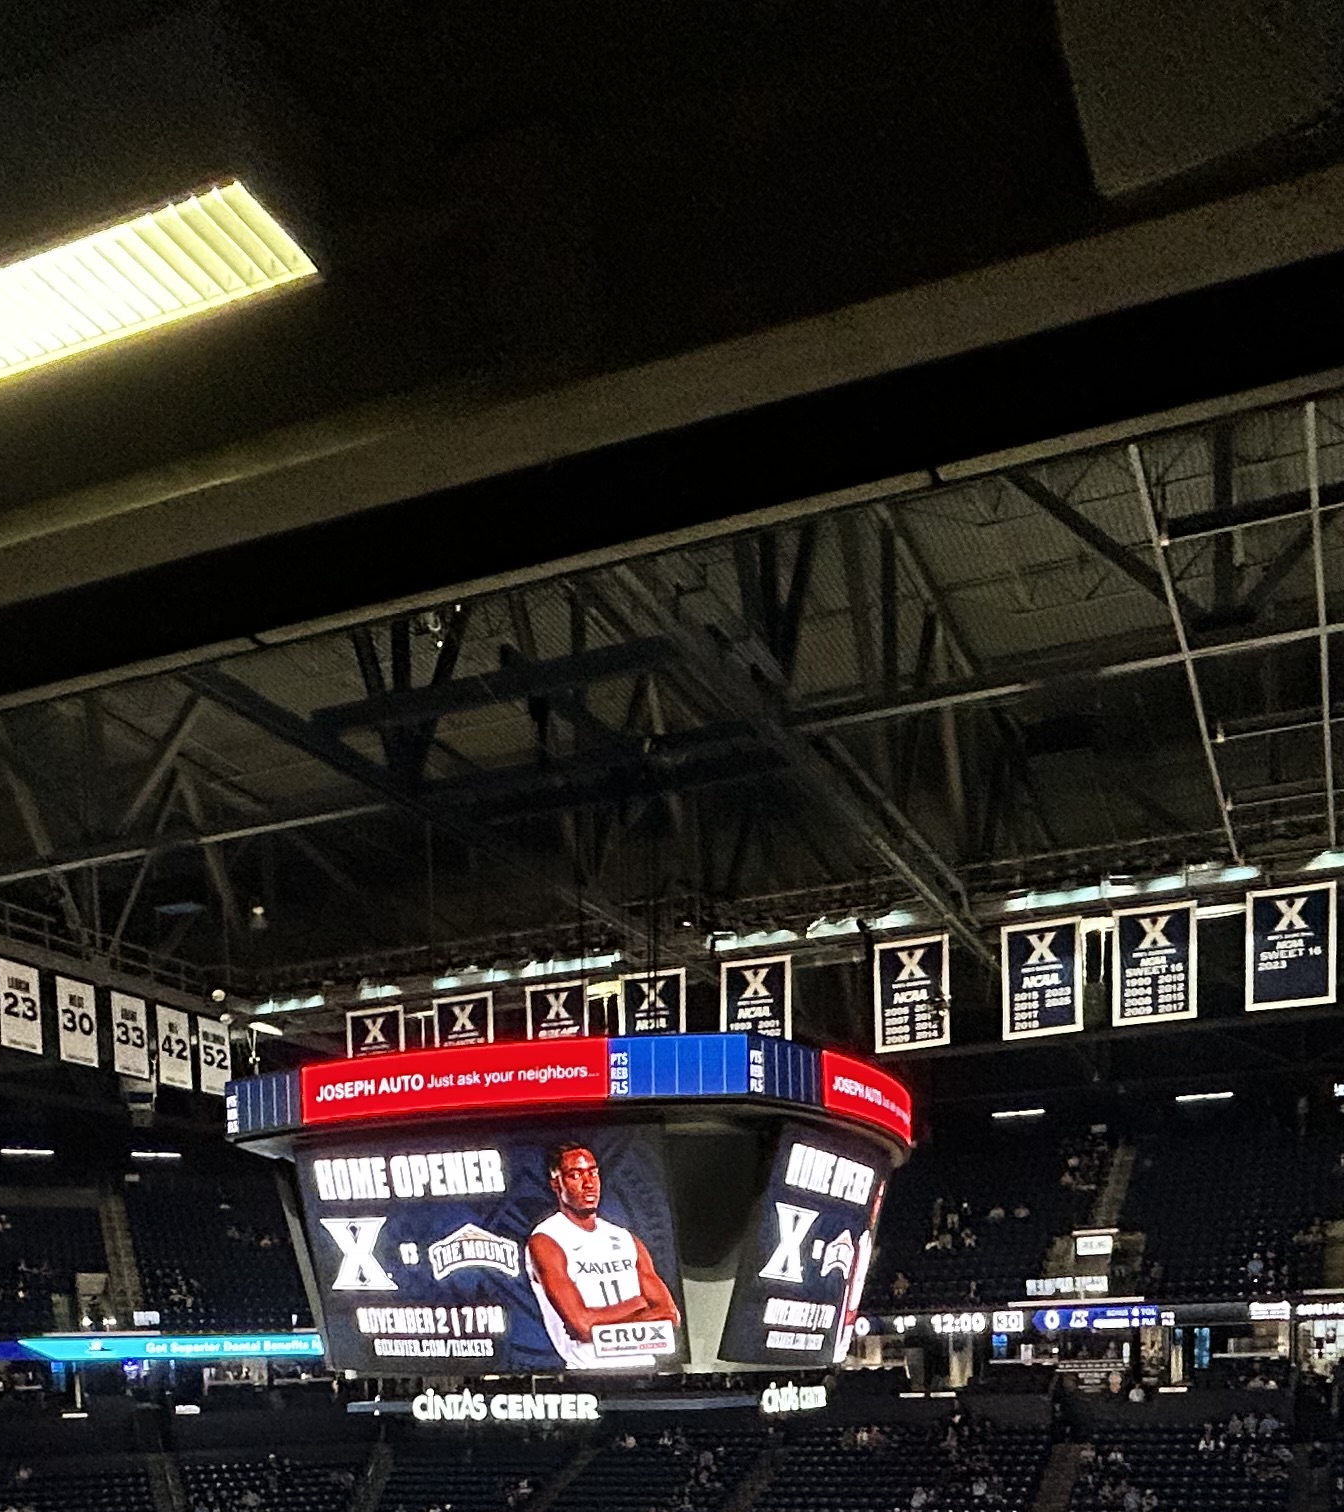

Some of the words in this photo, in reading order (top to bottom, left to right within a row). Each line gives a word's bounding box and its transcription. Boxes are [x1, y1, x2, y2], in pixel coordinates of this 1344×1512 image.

[1272, 897, 1311, 932] X
[1134, 915, 1174, 950] X
[1022, 932, 1061, 966] X
[1259, 948, 1306, 961] SWEET
[1307, 945, 1322, 956] 16
[895, 948, 931, 982] X
[1125, 964, 1168, 978] SWEET
[739, 967, 772, 1000] X
[1022, 973, 1063, 989] NCAA
[3, 991, 38, 1022] 23
[544, 991, 570, 1020] X
[893, 988, 931, 1005] NCAA
[61, 1008, 94, 1036] 30
[362, 1016, 387, 1044] X
[452, 1003, 476, 1031] X
[116, 1022, 145, 1049] 33
[162, 1035, 188, 1061] 42
[203, 1045, 229, 1070] 52
[610, 1051, 628, 1066] PTS
[316, 1078, 375, 1102] JOSEPH
[378, 1074, 424, 1095] AUTO
[426, 1073, 455, 1089] Just
[457, 1070, 481, 1086] ask
[483, 1071, 515, 1087] your
[610, 1066, 628, 1080] REB
[832, 1075, 864, 1098] JOSEPH
[610, 1081, 629, 1095] FLS
[314, 1155, 391, 1201] HOME
[390, 1148, 506, 1199] OPENER
[319, 1216, 399, 1291] X
[434, 1242, 461, 1271] THE
[461, 1240, 516, 1270] MOUNT
[758, 1201, 820, 1283] X
[575, 1259, 635, 1275] XAVIER
[599, 1279, 619, 1305] 11
[357, 1306, 434, 1334] NOVEMBER
[435, 1306, 451, 1334] 2
[464, 1306, 476, 1334] 7
[476, 1305, 506, 1334] PM
[931, 1311, 986, 1333] 12:00
[996, 1313, 1021, 1330] 30
[1044, 1310, 1060, 1330] 0
[598, 1325, 668, 1344] CRUX
[489, 1394, 601, 1421] CENTER
